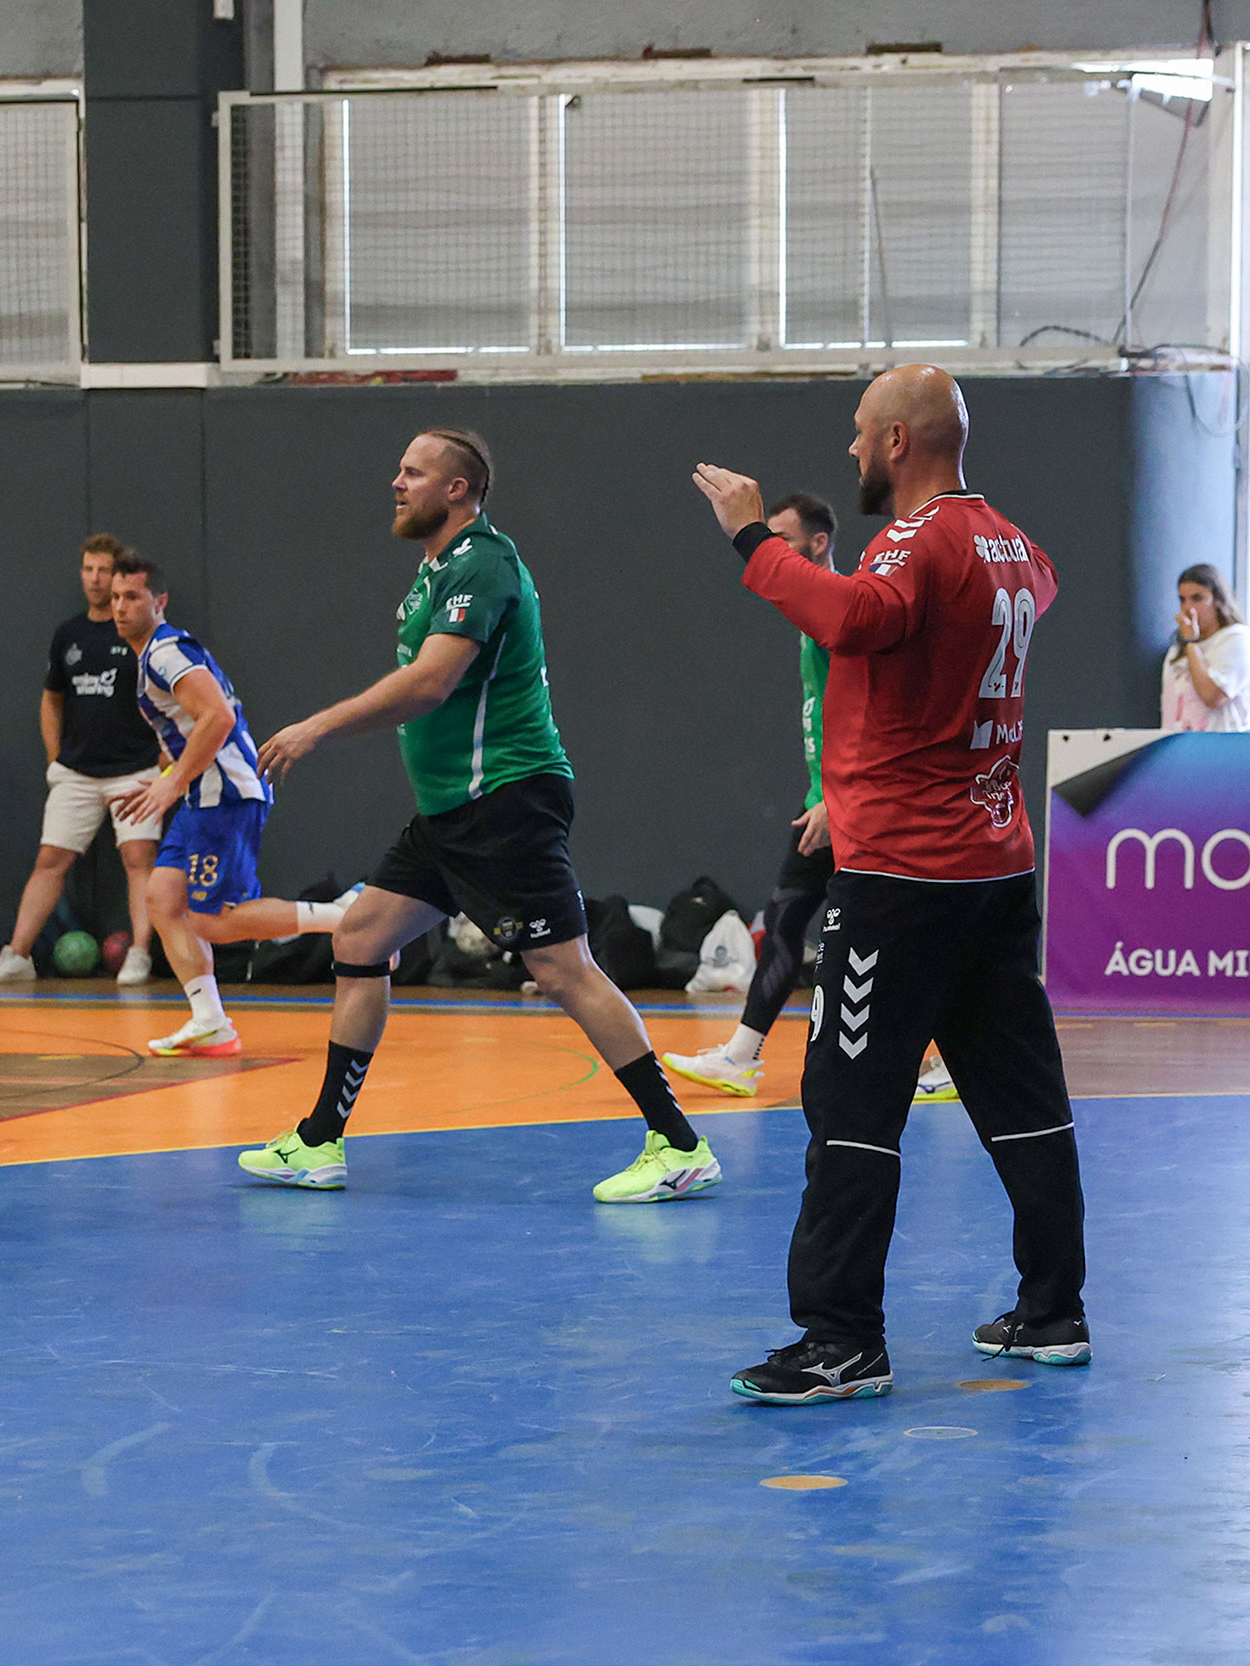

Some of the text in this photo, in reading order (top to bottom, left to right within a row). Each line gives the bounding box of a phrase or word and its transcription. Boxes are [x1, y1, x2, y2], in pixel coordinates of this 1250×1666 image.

[871, 549, 912, 566] EHF
[446, 594, 473, 609] EHF
[978, 587, 1036, 698] 29
[189, 853, 219, 887] 18
[1106, 828, 1250, 891] mo
[1104, 941, 1250, 978] ÁGUA MI
